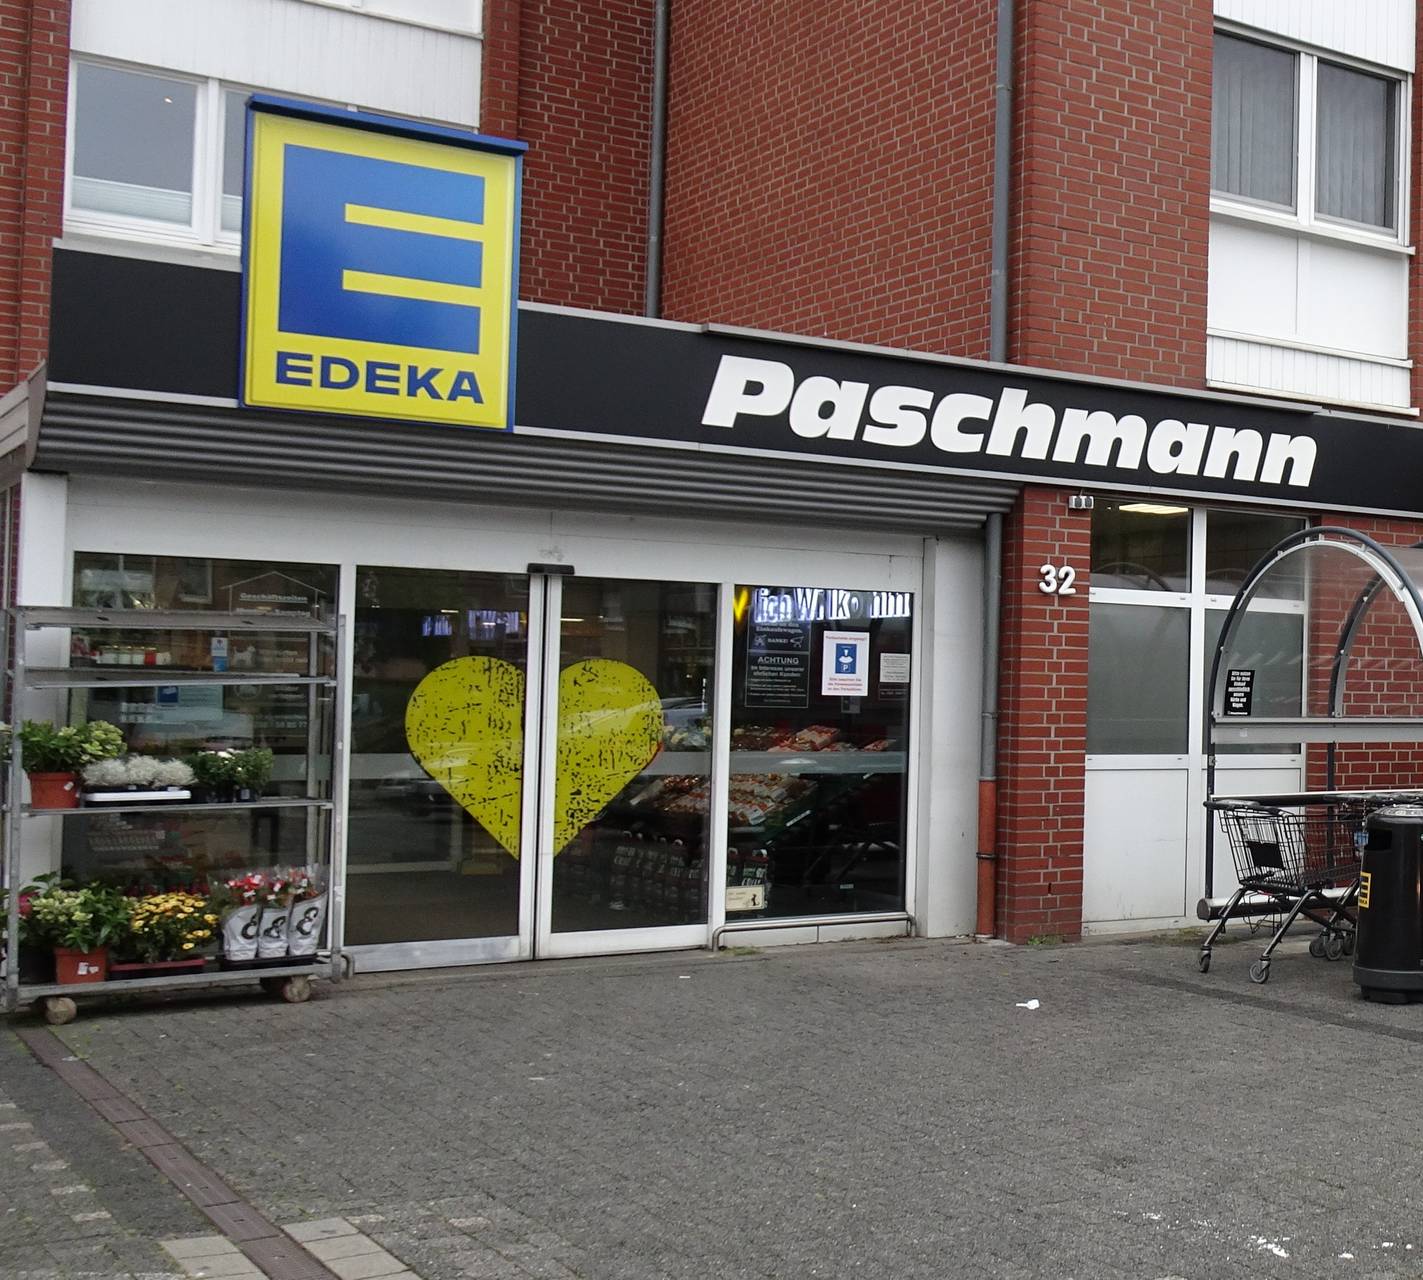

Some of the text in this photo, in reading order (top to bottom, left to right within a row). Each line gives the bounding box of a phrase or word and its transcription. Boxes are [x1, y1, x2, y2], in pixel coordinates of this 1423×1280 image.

[275, 350, 484, 404] EDEKA
[701, 354, 1318, 487] Paschmann
[1038, 563, 1077, 595] 32
[757, 656, 799, 665] ACHTUNG
